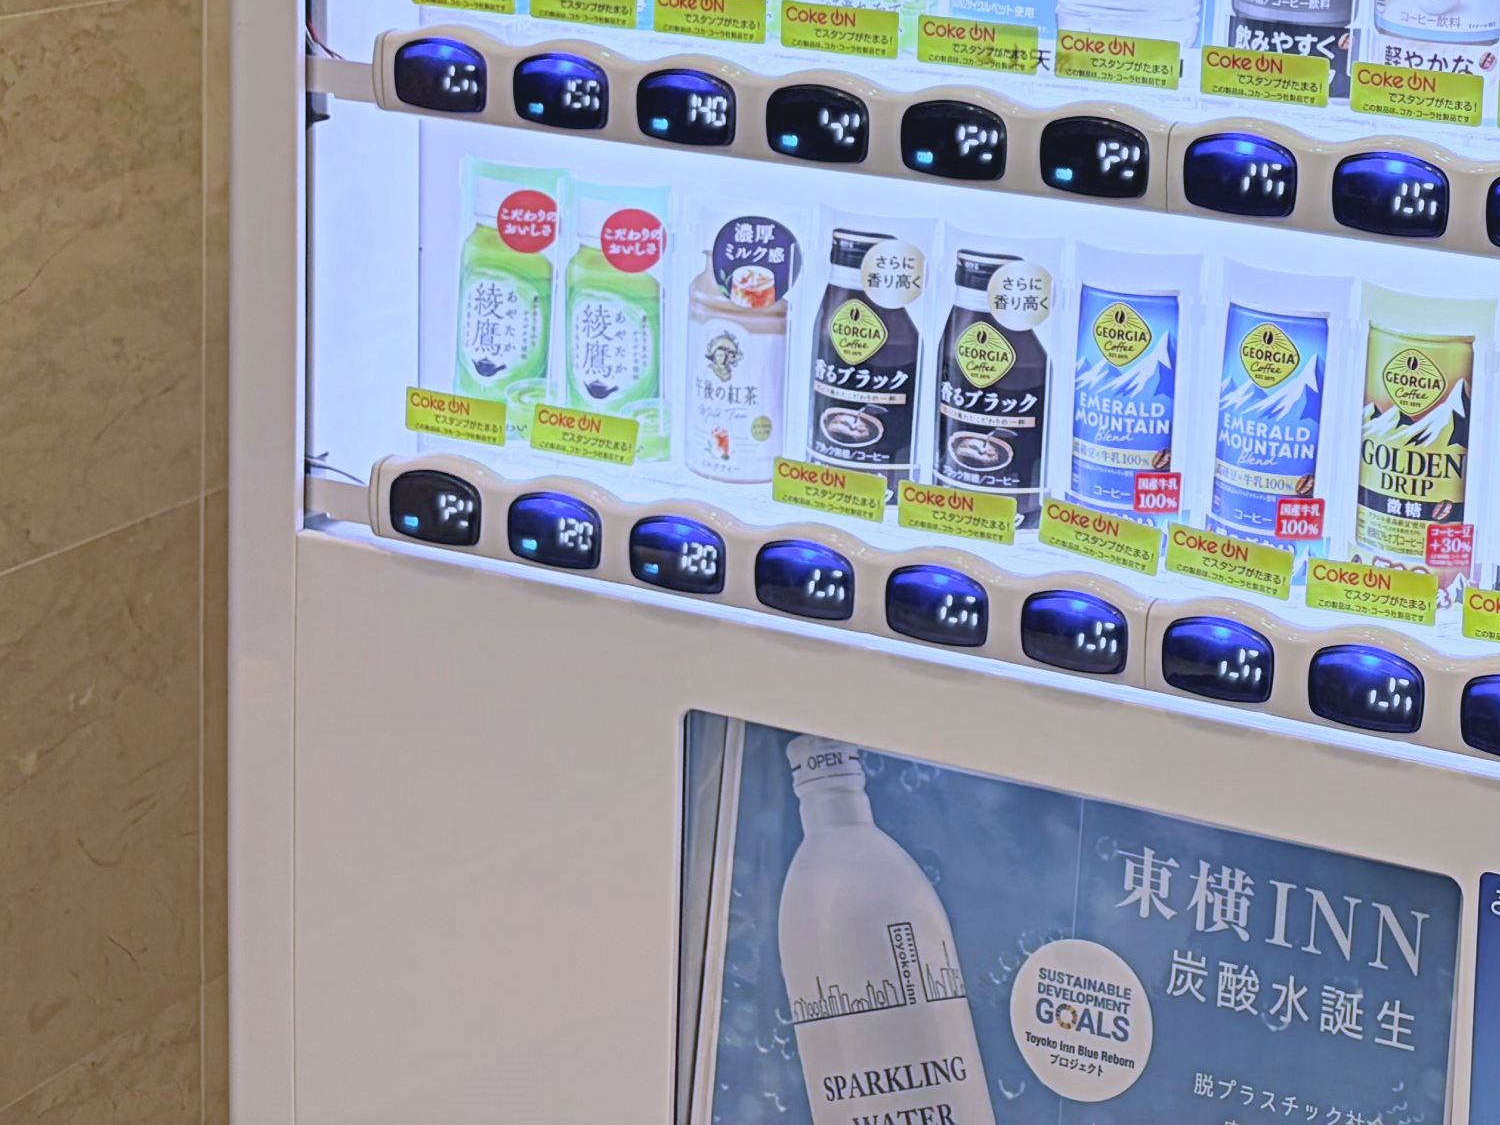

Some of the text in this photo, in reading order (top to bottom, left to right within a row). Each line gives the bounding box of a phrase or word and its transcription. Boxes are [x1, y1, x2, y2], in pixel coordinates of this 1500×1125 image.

[688, 94, 728, 127] 140
[735, 223, 775, 243] 濃厚
[724, 243, 785, 263] ミルク感
[875, 256, 914, 271] さらに
[867, 272, 921, 290] 香り高く
[941, 381, 1037, 414] 香るブラック
[1079, 392, 1165, 417] EMERALD
[1076, 409, 1170, 435] MOUNTAIN
[1362, 440, 1465, 480] GOLDEN
[1137, 478, 1178, 493] 国産牛乳
[1380, 473, 1434, 497] DRIP
[1138, 492, 1177, 509] 100%
[1386, 499, 1423, 520] 微糖
[1114, 846, 1429, 976] 東横INN
[1038, 966, 1132, 1001] SUSTAINABLE
[1038, 982, 1131, 1016] DEVELOPMENT
[1166, 948, 1417, 1053] 炭酸水誕生
[1035, 999, 1130, 1044] GOALS
[1026, 1031, 1136, 1070] Toyoko Inn Blue Reborn
[824, 1056, 968, 1102] SPARKLING
